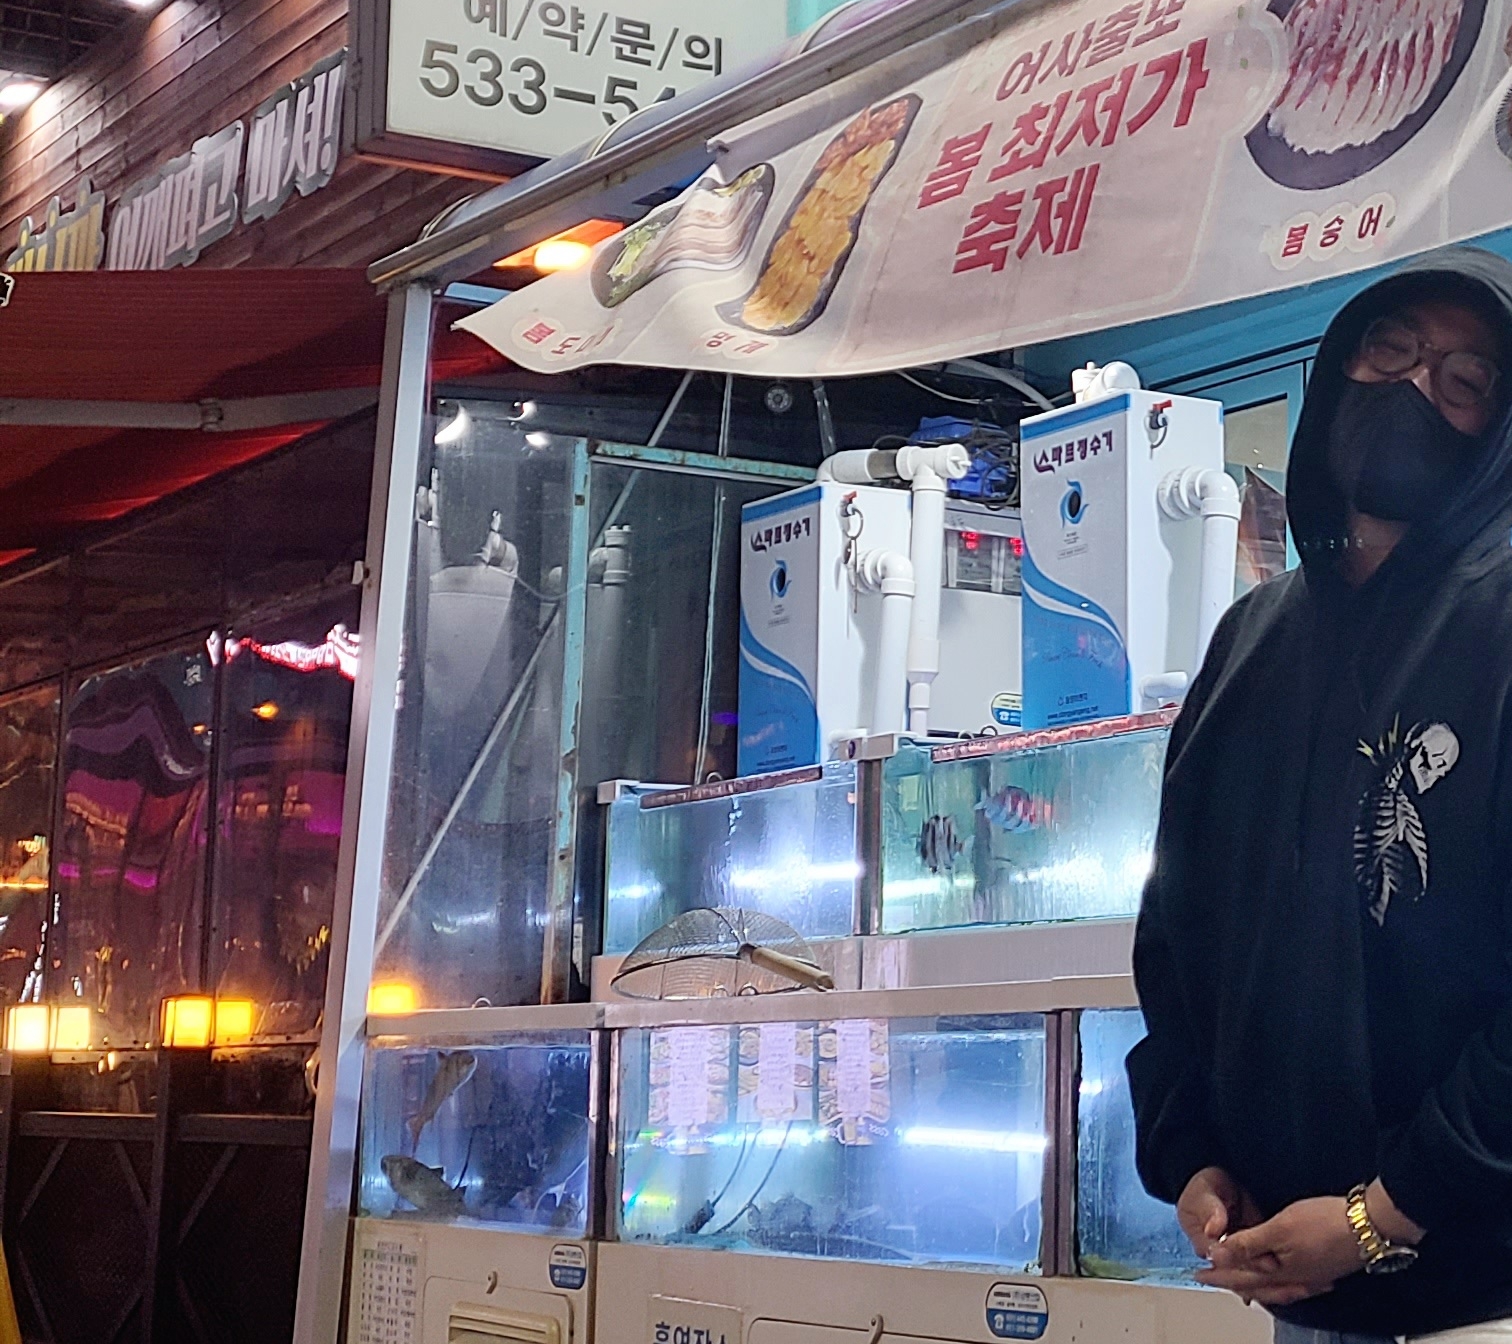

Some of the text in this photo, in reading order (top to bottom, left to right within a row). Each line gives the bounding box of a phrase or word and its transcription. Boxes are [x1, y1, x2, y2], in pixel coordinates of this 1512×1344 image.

[917, 37, 1211, 210] 봄 최저가
[952, 162, 1100, 274] 축제
[1033, 429, 1113, 475] 스마트정수기
